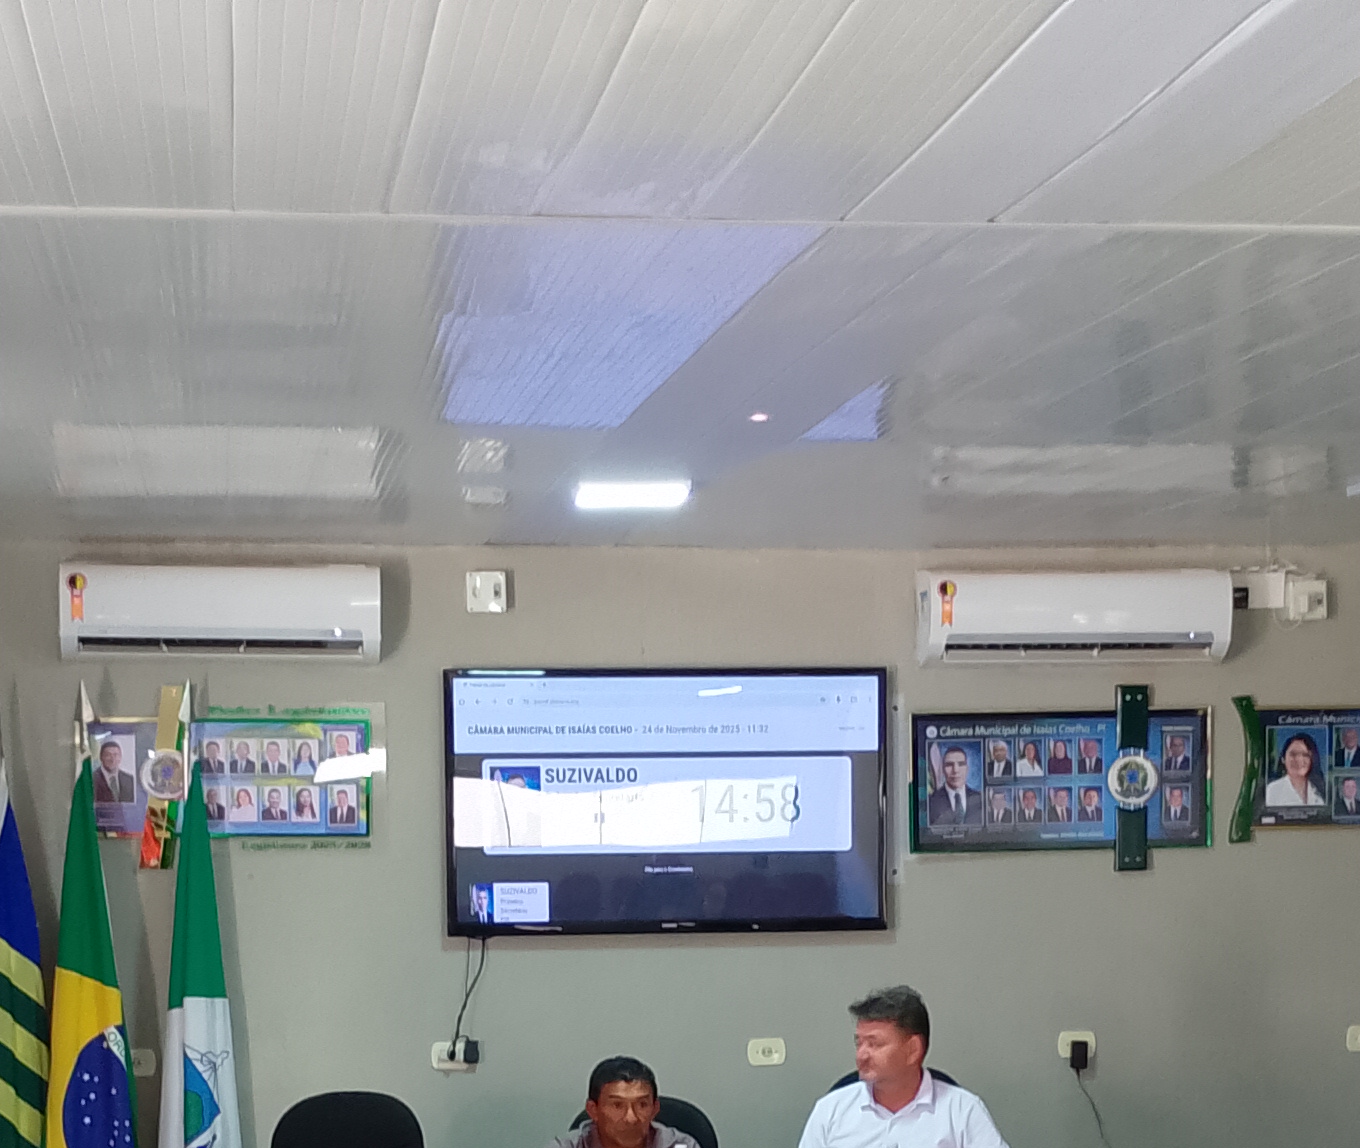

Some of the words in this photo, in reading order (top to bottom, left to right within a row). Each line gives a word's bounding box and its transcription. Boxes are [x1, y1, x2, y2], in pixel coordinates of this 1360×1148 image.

[467, 723, 505, 735] CÂMARA
[506, 725, 553, 735] MUNICIPAL
[555, 725, 566, 734] DE
[568, 723, 597, 735] ISAÍAS
[599, 724, 633, 734] COELHO
[642, 724, 653, 734] 24
[654, 724, 664, 734] de
[666, 724, 707, 736] Novembro
[708, 724, 718, 734] de
[720, 723, 741, 734] 2025
[975, 724, 1018, 737] Municipal
[1019, 724, 1031, 735] de
[544, 767, 638, 783] SUZIVALDO
[691, 783, 801, 823] 14:58
